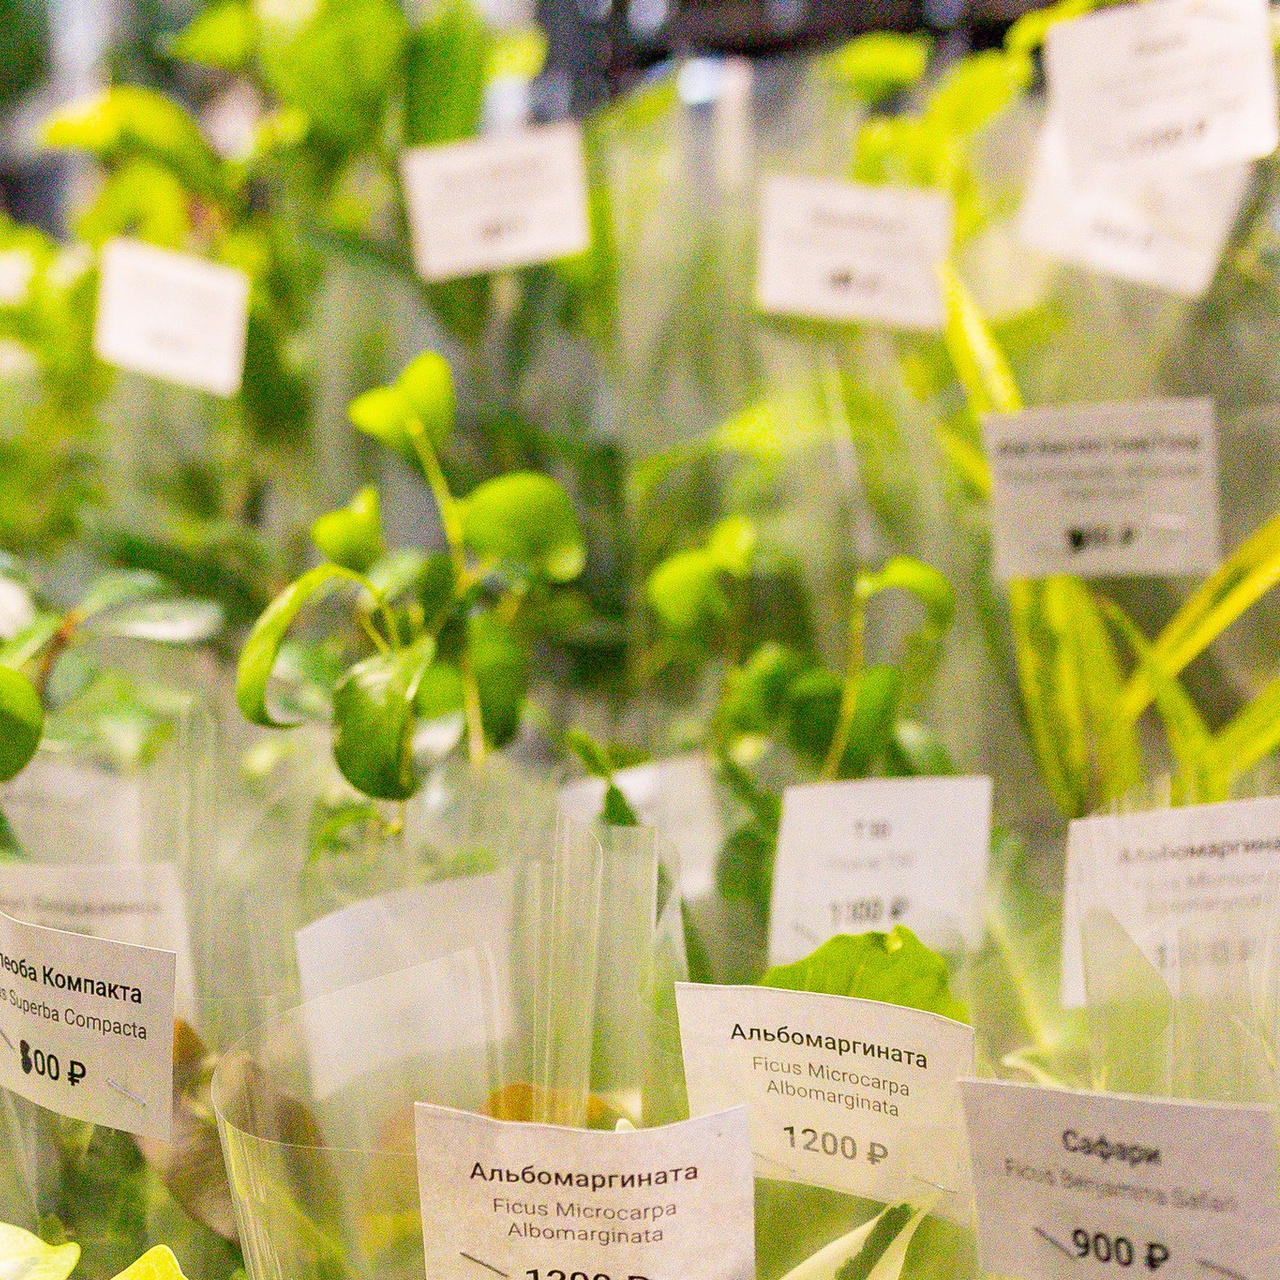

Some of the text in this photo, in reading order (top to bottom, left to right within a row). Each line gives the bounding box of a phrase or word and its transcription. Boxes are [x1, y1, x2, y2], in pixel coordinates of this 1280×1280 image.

[43, 965, 142, 1004] Компакта
[9, 989, 59, 1022] Superba
[64, 1008, 147, 1040] Compacta
[730, 1023, 928, 1069] Альбомаргината
[752, 1056, 910, 1097] Ficus Microcarpa
[767, 1080, 899, 1117] Albomarginata
[783, 1126, 857, 1161] 1200
[1062, 1129, 1161, 1166] Сафари
[470, 1162, 698, 1192] Альбомаргината
[493, 1198, 677, 1222] Ficus Microcarpa
[507, 1223, 663, 1246] Albomarginata
[1072, 1229, 1134, 1267] 900
